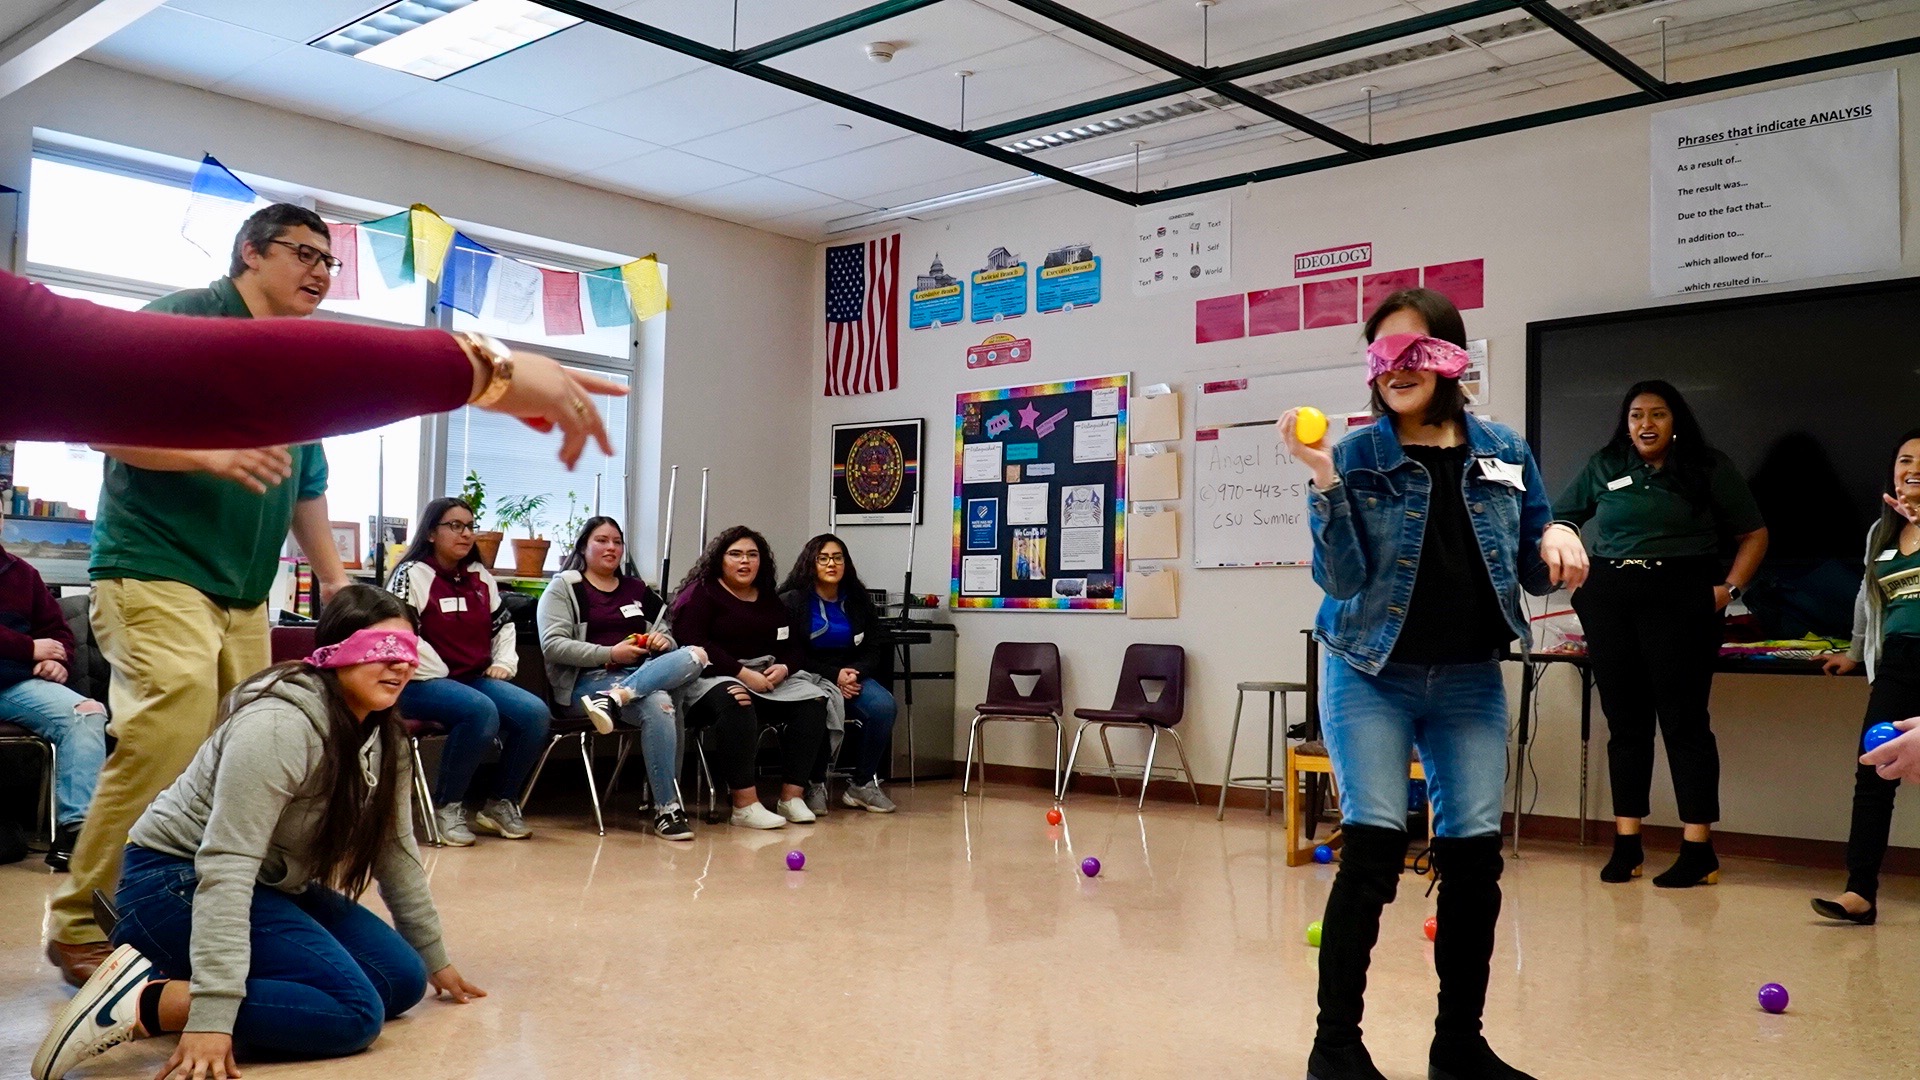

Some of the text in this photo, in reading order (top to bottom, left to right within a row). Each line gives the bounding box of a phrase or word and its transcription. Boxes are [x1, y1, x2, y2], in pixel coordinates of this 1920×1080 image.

[1678, 104, 1872, 147] Phrases that indicate ANALYSIS
[1677, 164, 1688, 172] As
[1698, 158, 1723, 169] result
[1677, 188, 1694, 196] The
[1695, 183, 1721, 193] result
[1678, 212, 1695, 221] Due
[1697, 210, 1707, 218] to
[1709, 207, 1724, 216] the
[1726, 204, 1743, 214] fact
[1207, 220, 1221, 228] Text
[1678, 236, 1686, 245] In
[1688, 232, 1725, 244] addition
[1207, 243, 1220, 252] Self
[1296, 248, 1370, 271] IDEOLOGY
[1713, 252, 1749, 265] allowed
[980, 269, 1018, 282] Judicial Branch
[1045, 262, 1093, 277] Executive Branch
[1138, 279, 1152, 287] Text
[1205, 267, 1223, 276] World
[1712, 277, 1750, 289] resulted
[915, 286, 958, 300] Legislative Branch
[1209, 445, 1260, 474] Angel
[1212, 512, 1243, 529] CSU
[1253, 509, 1301, 526] Summer
